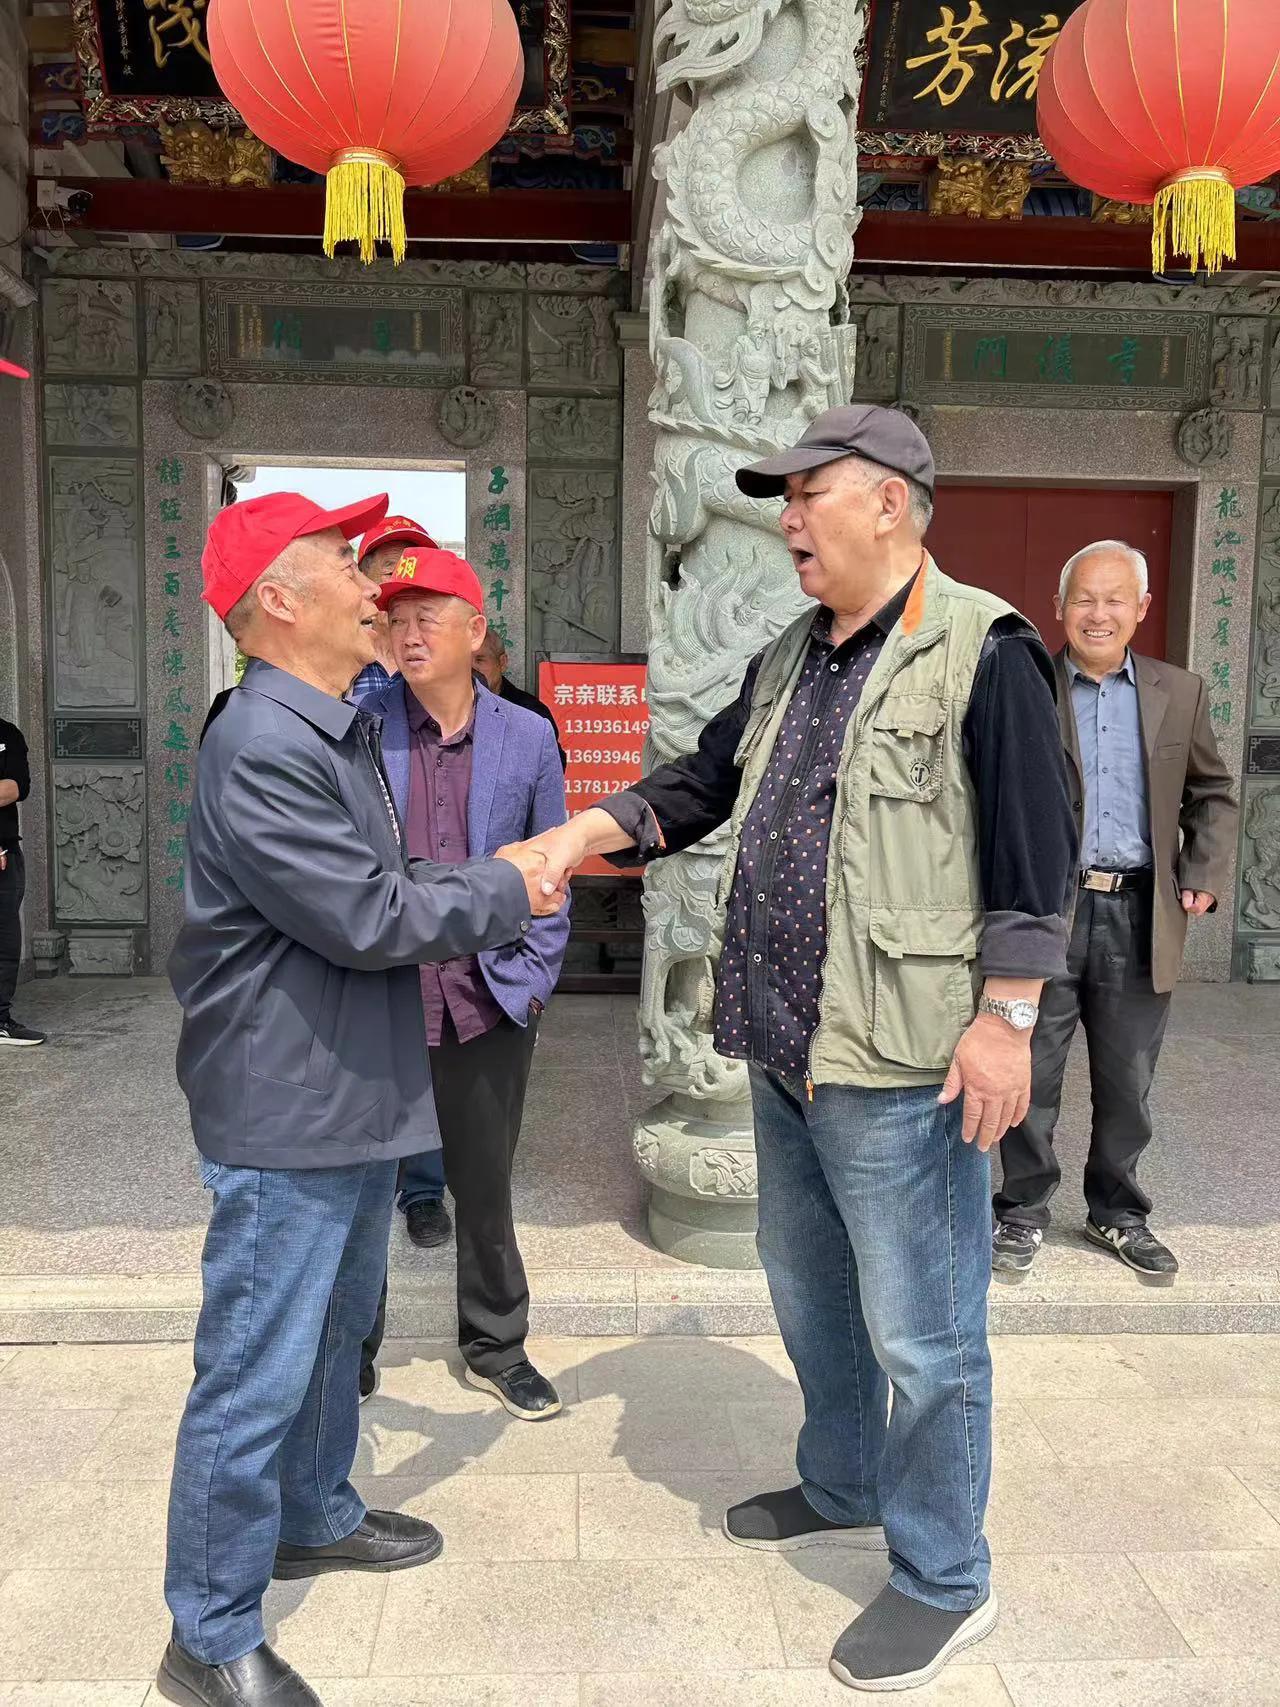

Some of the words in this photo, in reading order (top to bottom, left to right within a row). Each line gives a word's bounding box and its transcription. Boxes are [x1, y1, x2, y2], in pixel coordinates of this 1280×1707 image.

[554, 684, 647, 706] 宗亲联系
[565, 719, 650, 735] 131936149
[566, 749, 641, 764] 13693946
[564, 779, 638, 794] 1378128
